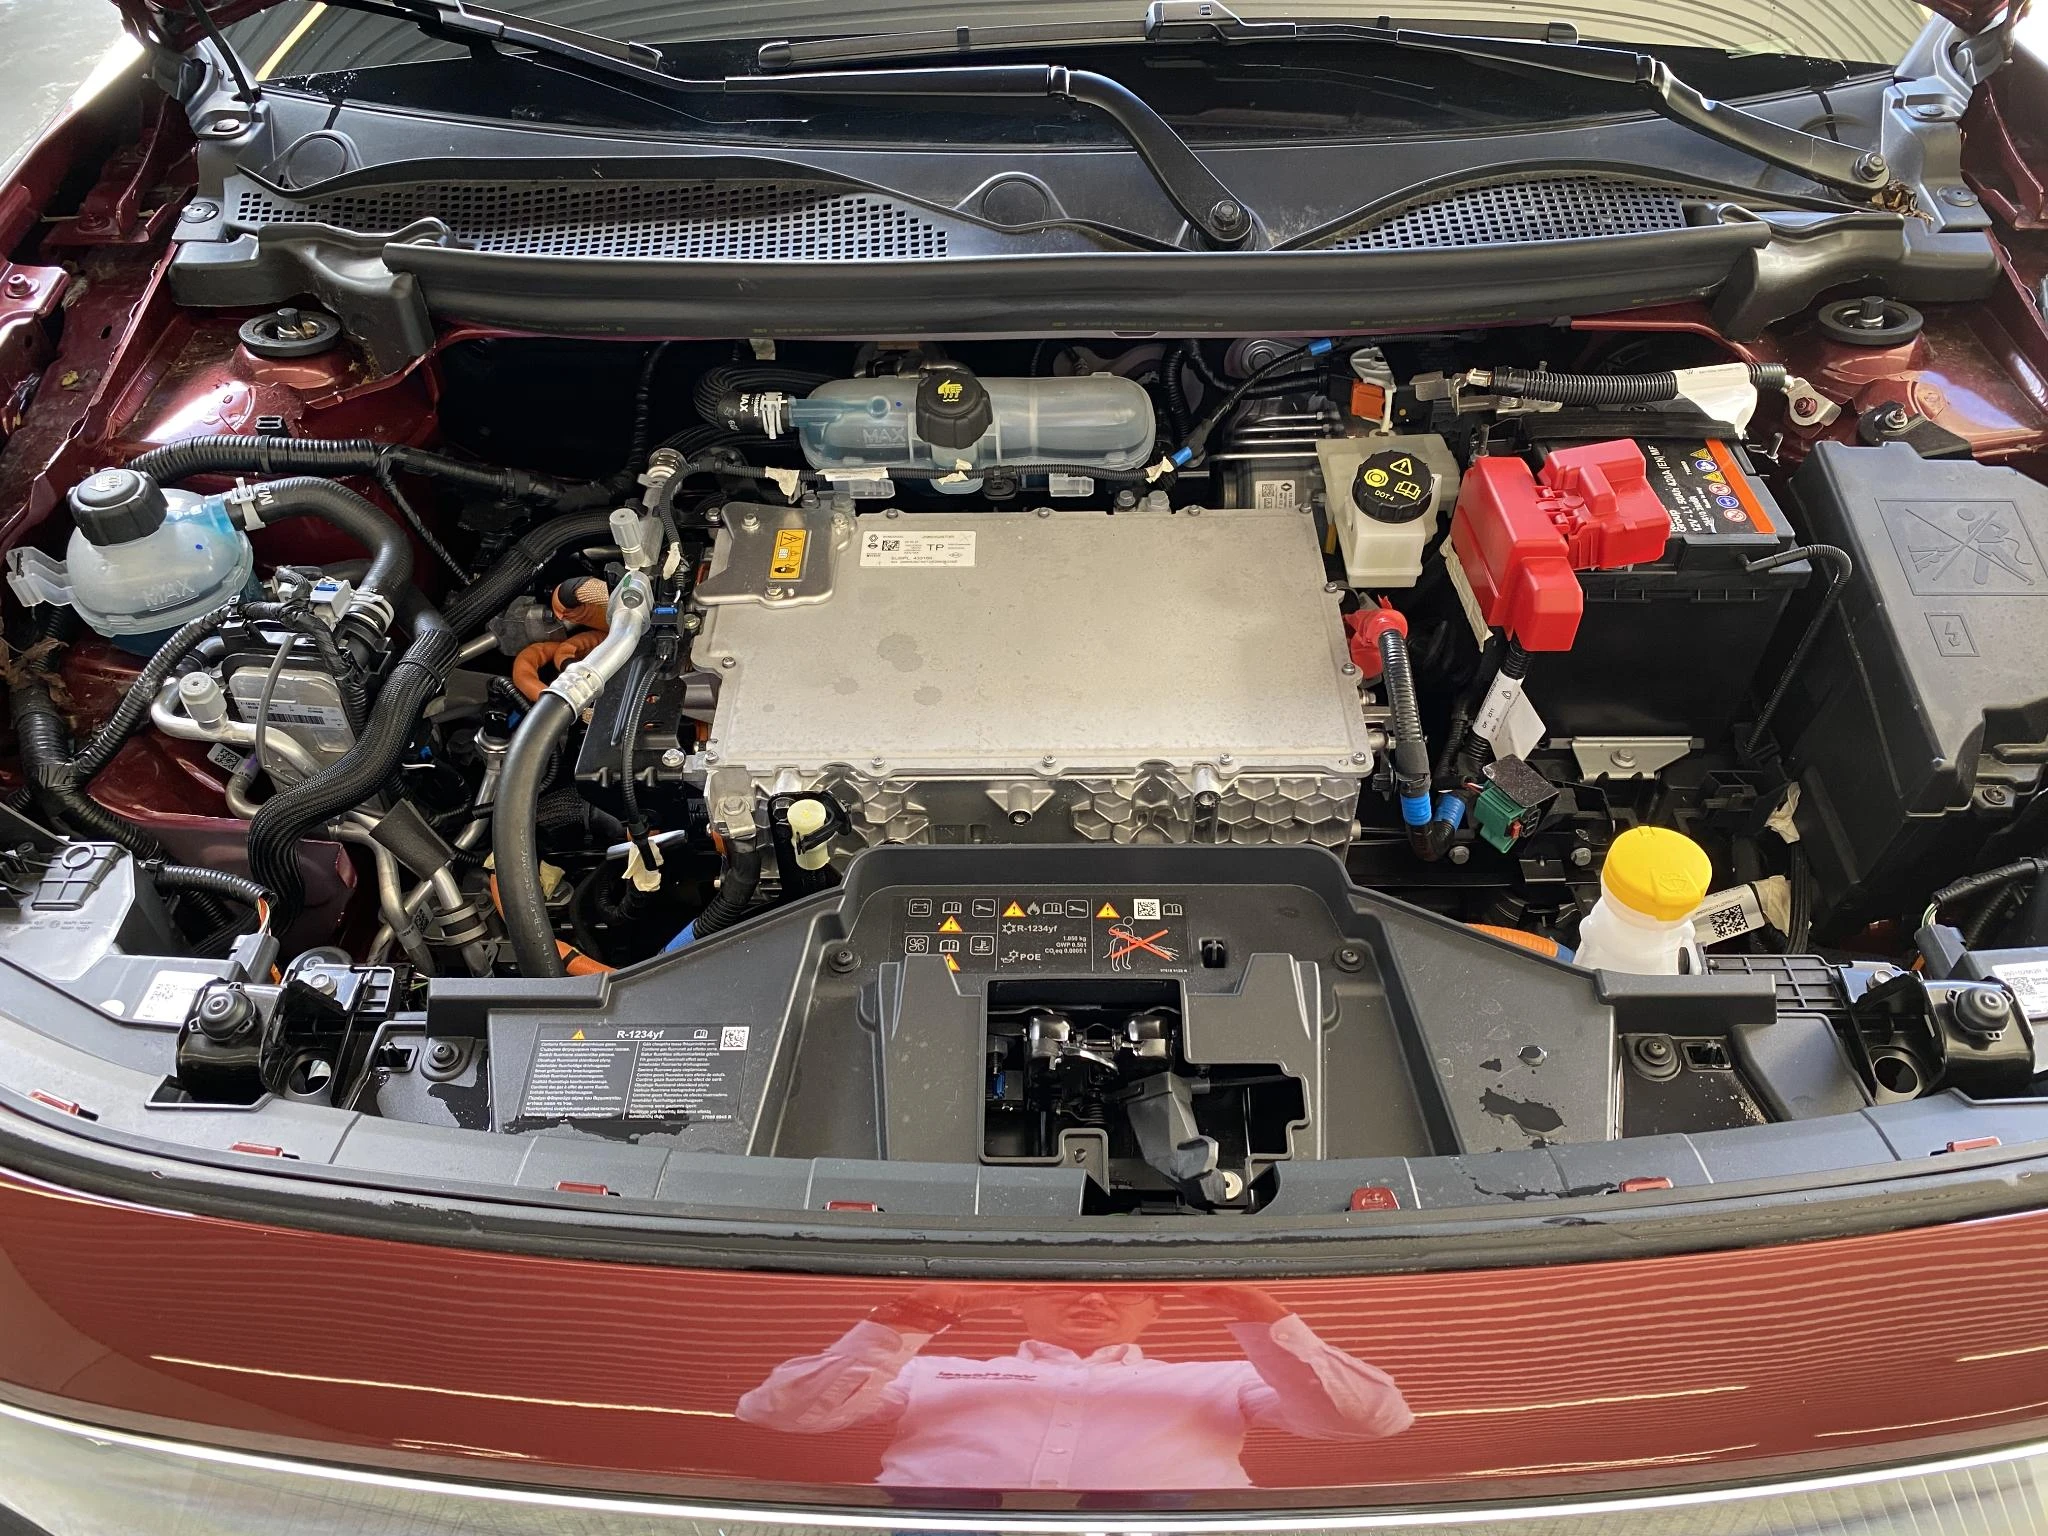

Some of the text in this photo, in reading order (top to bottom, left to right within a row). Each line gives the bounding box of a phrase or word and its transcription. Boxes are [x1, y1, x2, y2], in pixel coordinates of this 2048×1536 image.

[862, 427, 906, 445] MAX
[1375, 490, 1390, 499] DOT
[1688, 518, 1703, 531] 12V
[926, 543, 945, 551] TP
[1016, 924, 1058, 933] R-1234yf
[1020, 953, 1042, 961] POE
[616, 1030, 665, 1040] R-1234yf
